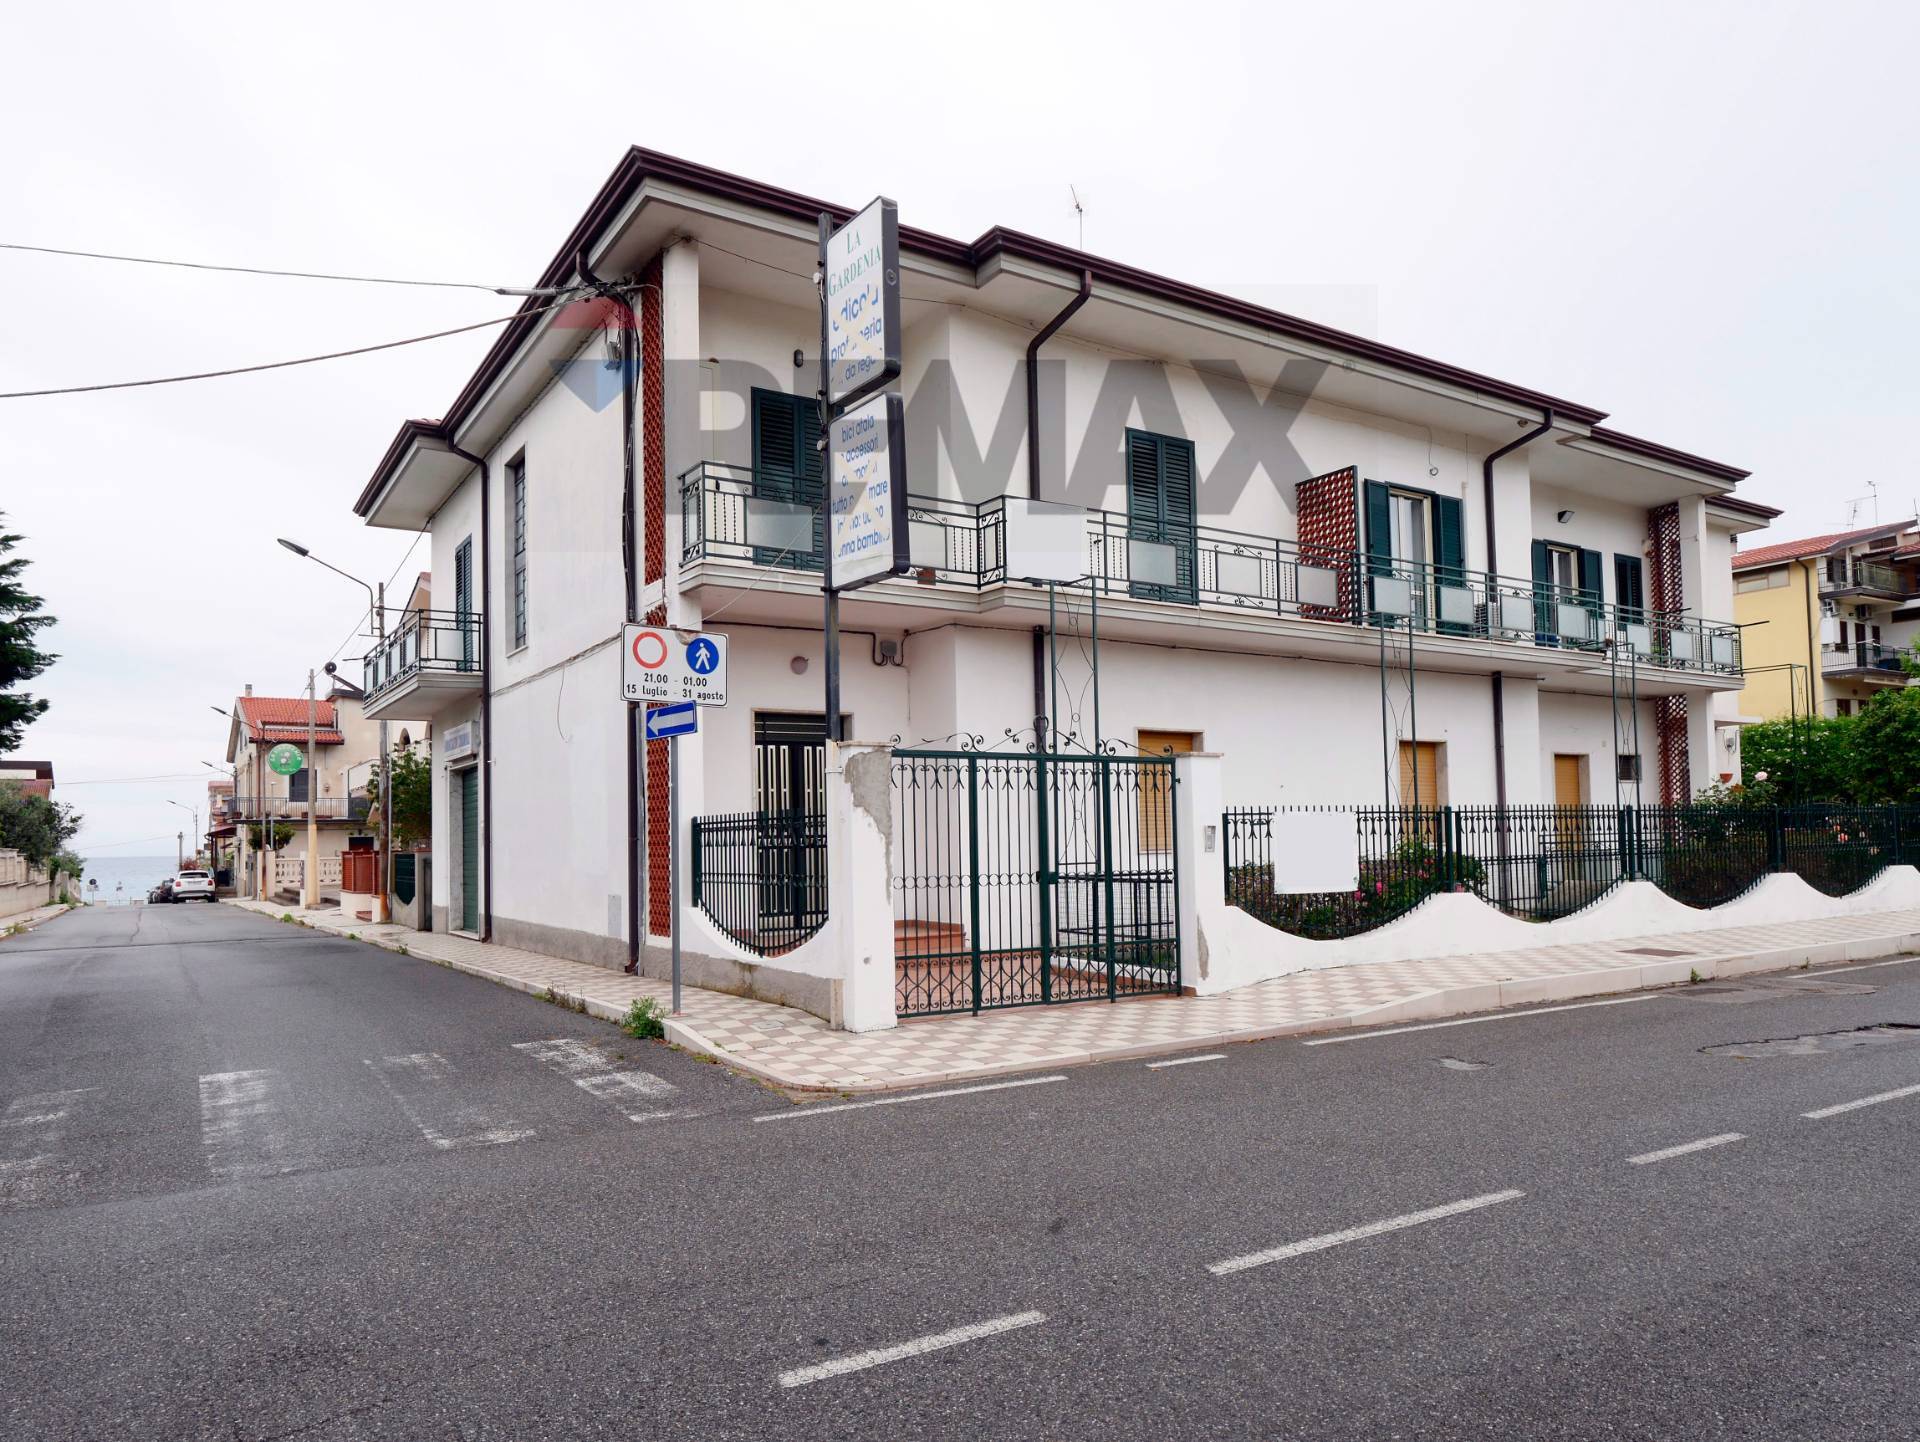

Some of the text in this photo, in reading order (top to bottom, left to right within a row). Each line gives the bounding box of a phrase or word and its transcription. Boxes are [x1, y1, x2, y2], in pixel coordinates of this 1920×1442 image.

[847, 231, 861, 254] LA
[828, 244, 881, 296] GARDENIA
[868, 480, 888, 499] mare
[644, 672, 668, 684] 21.00
[683, 676, 707, 688] 01.00
[626, 684, 637, 694] 15
[642, 685, 668, 697] luglio
[682, 688, 692, 698] 31
[697, 690, 724, 701] agosto
